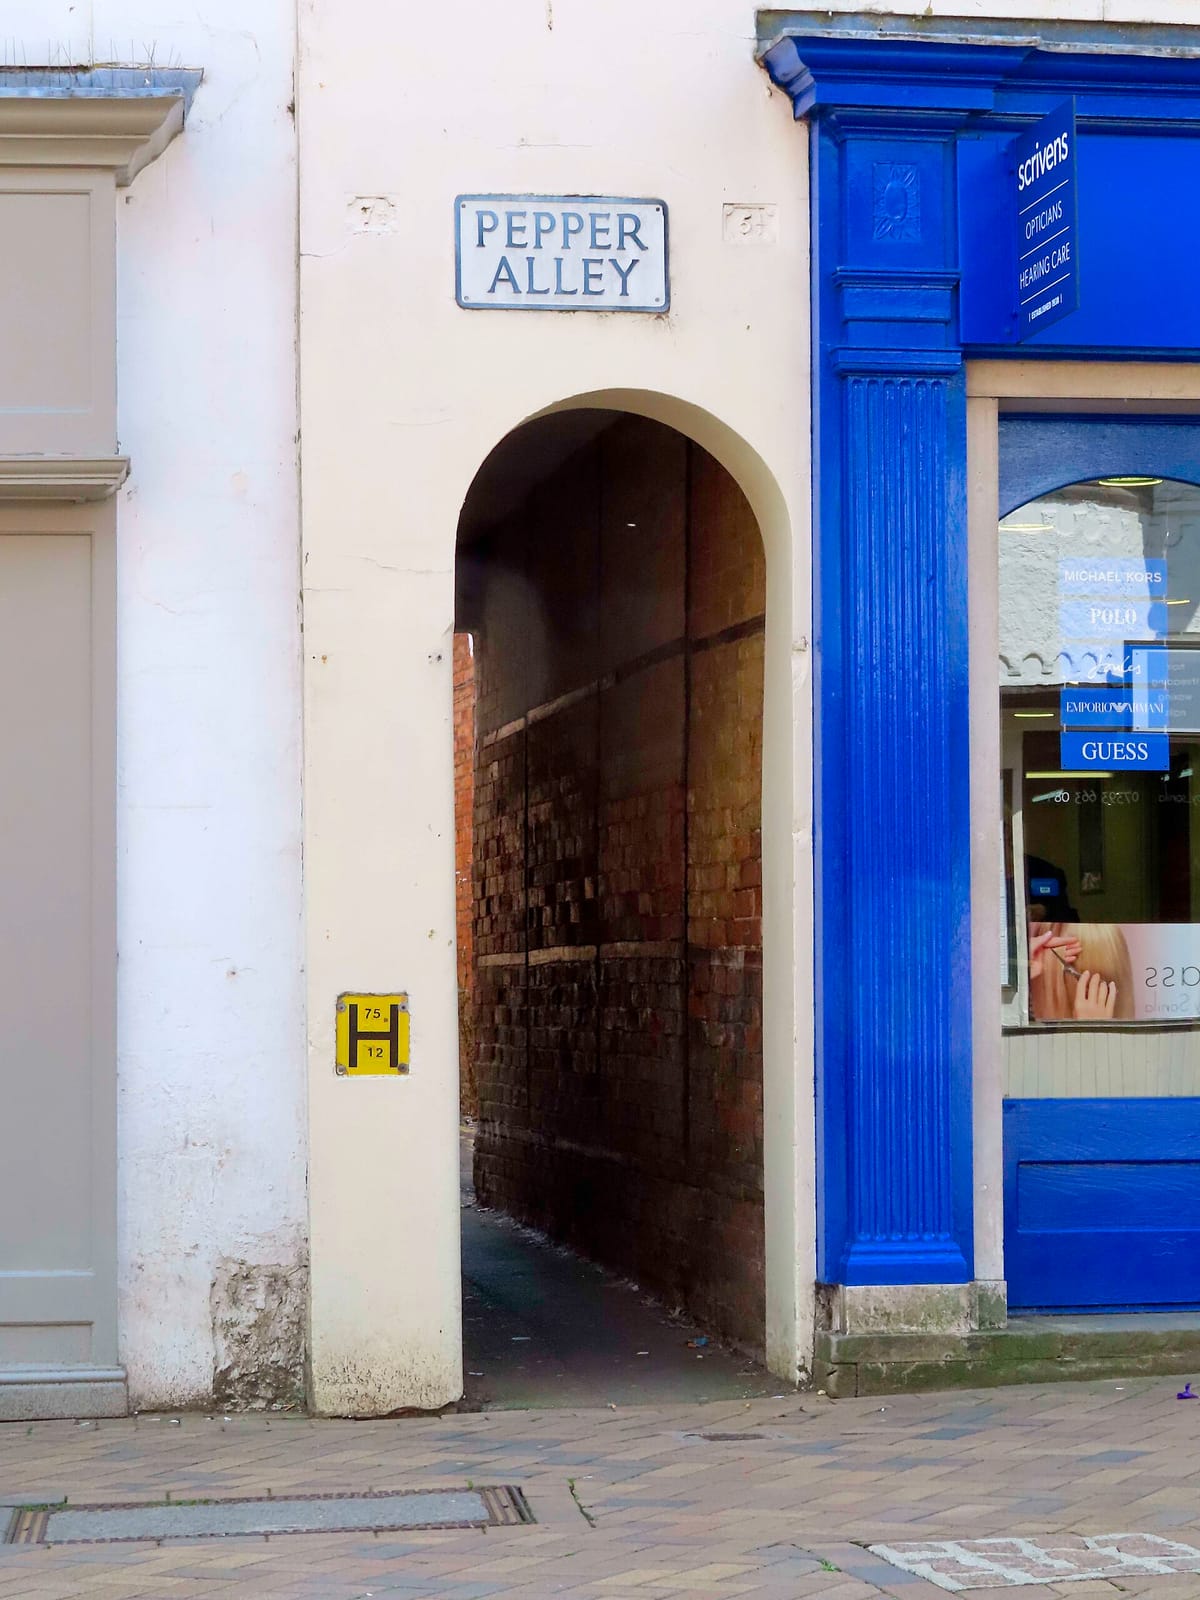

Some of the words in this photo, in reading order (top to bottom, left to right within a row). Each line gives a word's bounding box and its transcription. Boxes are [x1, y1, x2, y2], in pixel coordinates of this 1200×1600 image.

[1018, 132, 1069, 191] scrivens
[475, 210, 649, 251] PEPPER
[1025, 200, 1063, 240] OPTICIANS
[486, 255, 640, 297] ALLEY
[1019, 255, 1050, 290] HEARING
[1051, 241, 1071, 269] CARE
[1064, 570, 1121, 582] MICHAEL
[1126, 572, 1162, 583] KORS
[1089, 607, 1137, 625] POLO
[1066, 701, 1113, 713] EMPORIO
[1126, 703, 1164, 713] ARMANI
[1082, 741, 1149, 761] GUESS
[364, 1008, 381, 1019] 75
[348, 1003, 399, 1068] H
[367, 1047, 384, 1058] 12
